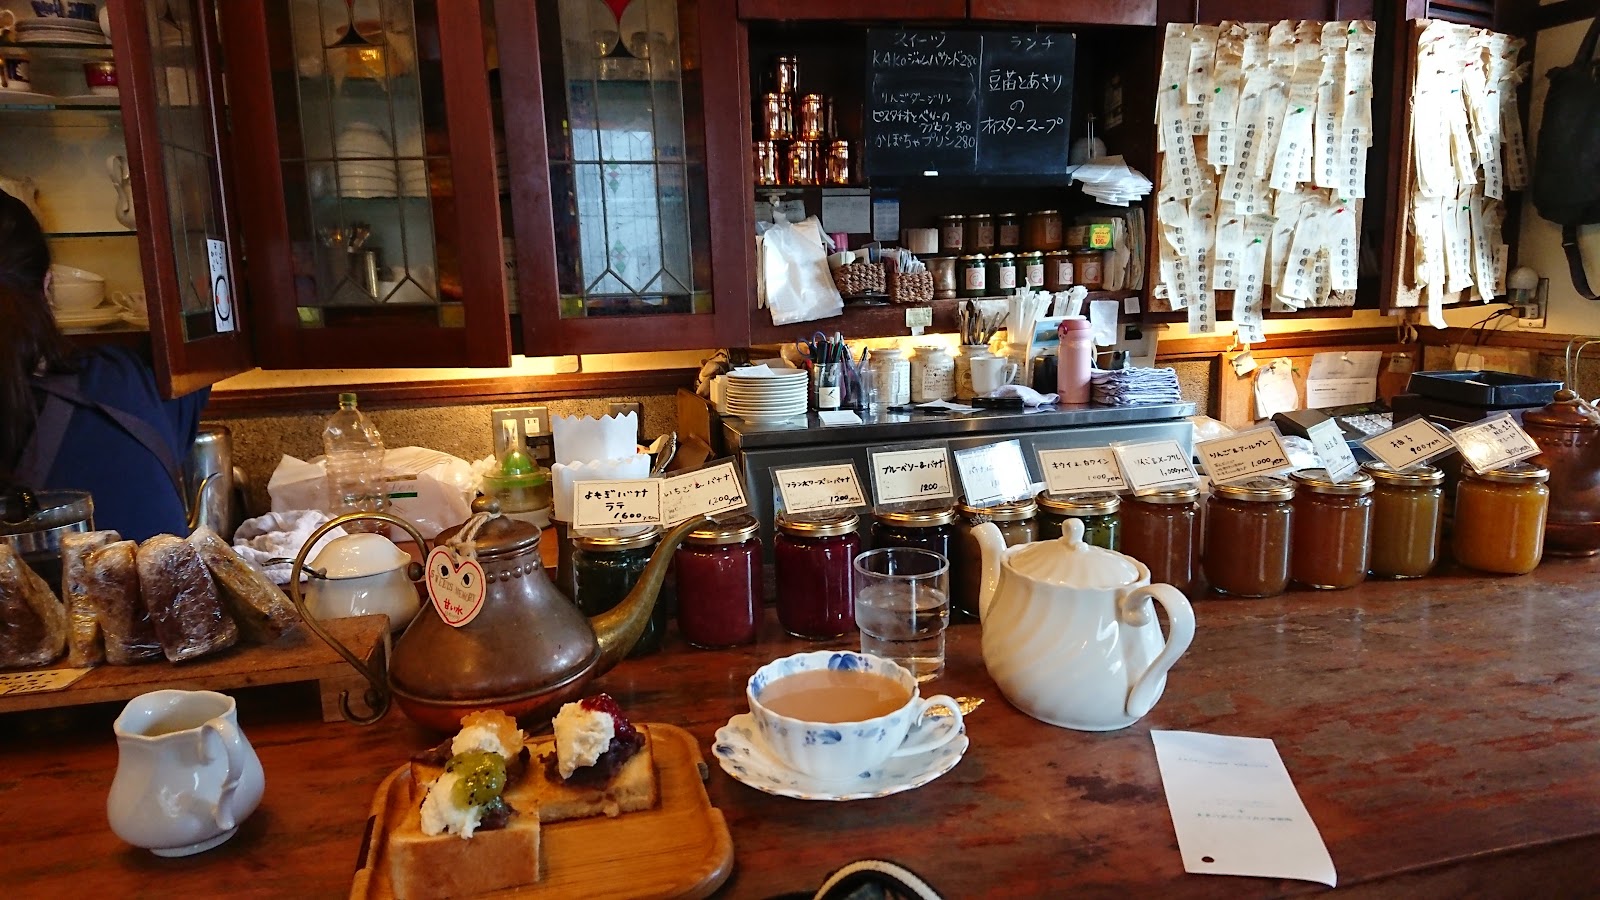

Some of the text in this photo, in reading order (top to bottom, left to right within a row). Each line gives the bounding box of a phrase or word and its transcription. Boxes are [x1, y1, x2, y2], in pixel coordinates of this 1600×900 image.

[893, 31, 947, 48] スイーツ
[1010, 35, 1055, 51] ランチ
[988, 69, 1063, 93] 豆苗とあさり
[1009, 99, 1025, 113] の
[872, 109, 950, 123] ピスタチオとベリーの
[980, 116, 1064, 135] オイスタースープ
[584, 488, 649, 499] よもぎバナナ
[605, 502, 625, 511] ラテ
[443, 598, 463, 615] 甘い水
